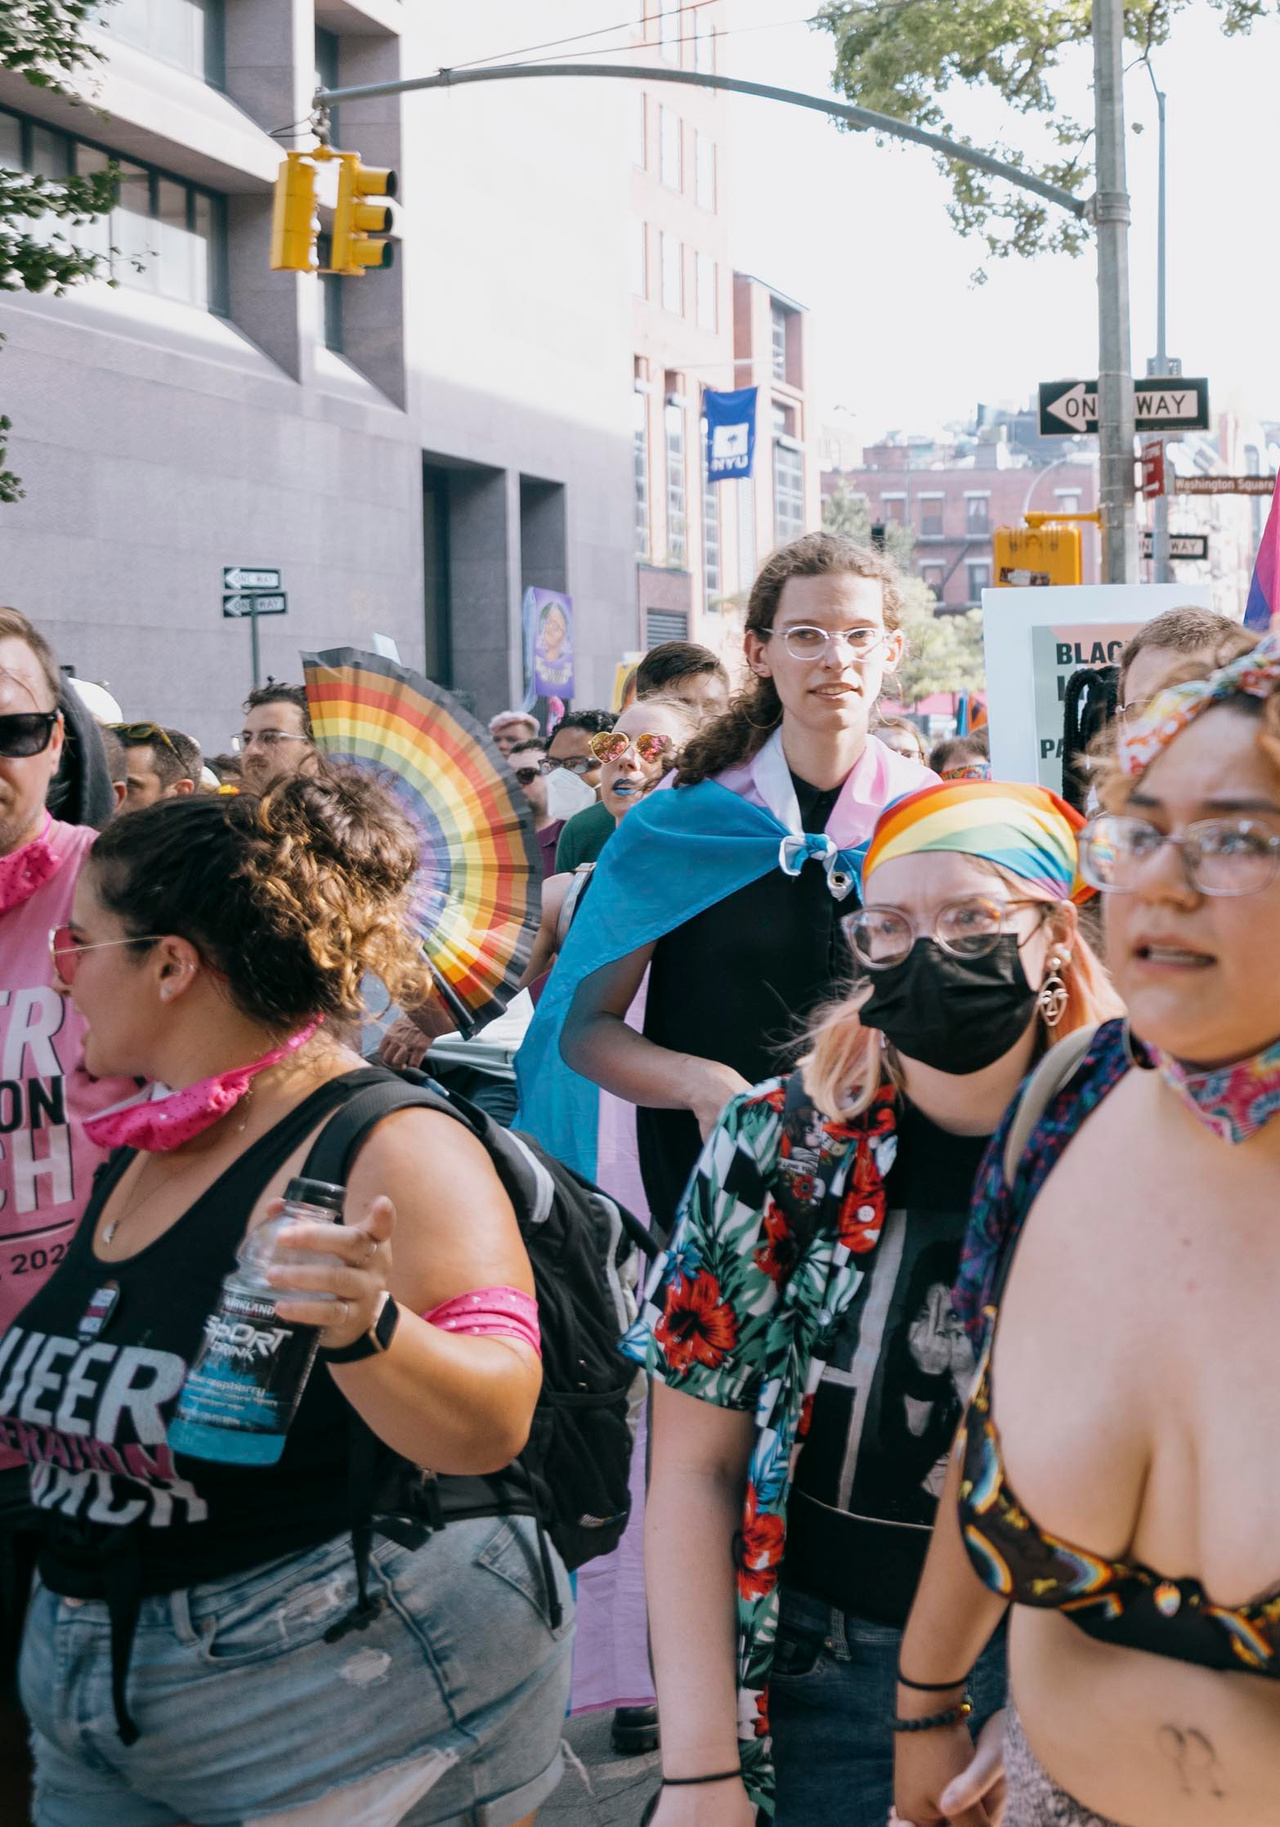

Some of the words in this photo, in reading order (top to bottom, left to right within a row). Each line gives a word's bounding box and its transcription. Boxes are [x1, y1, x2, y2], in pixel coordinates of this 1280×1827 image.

[1065, 397, 1097, 418] ON
[1136, 394, 1186, 416] WAY
[711, 454, 749, 472] NYU
[1175, 478, 1235, 493] Washington
[1237, 478, 1275, 492] Square
[1171, 541, 1198, 551] WAY
[1056, 640, 1128, 666] BLAC
[10, 1240, 72, 1276] 202
[203, 1314, 294, 1358] SPORT
